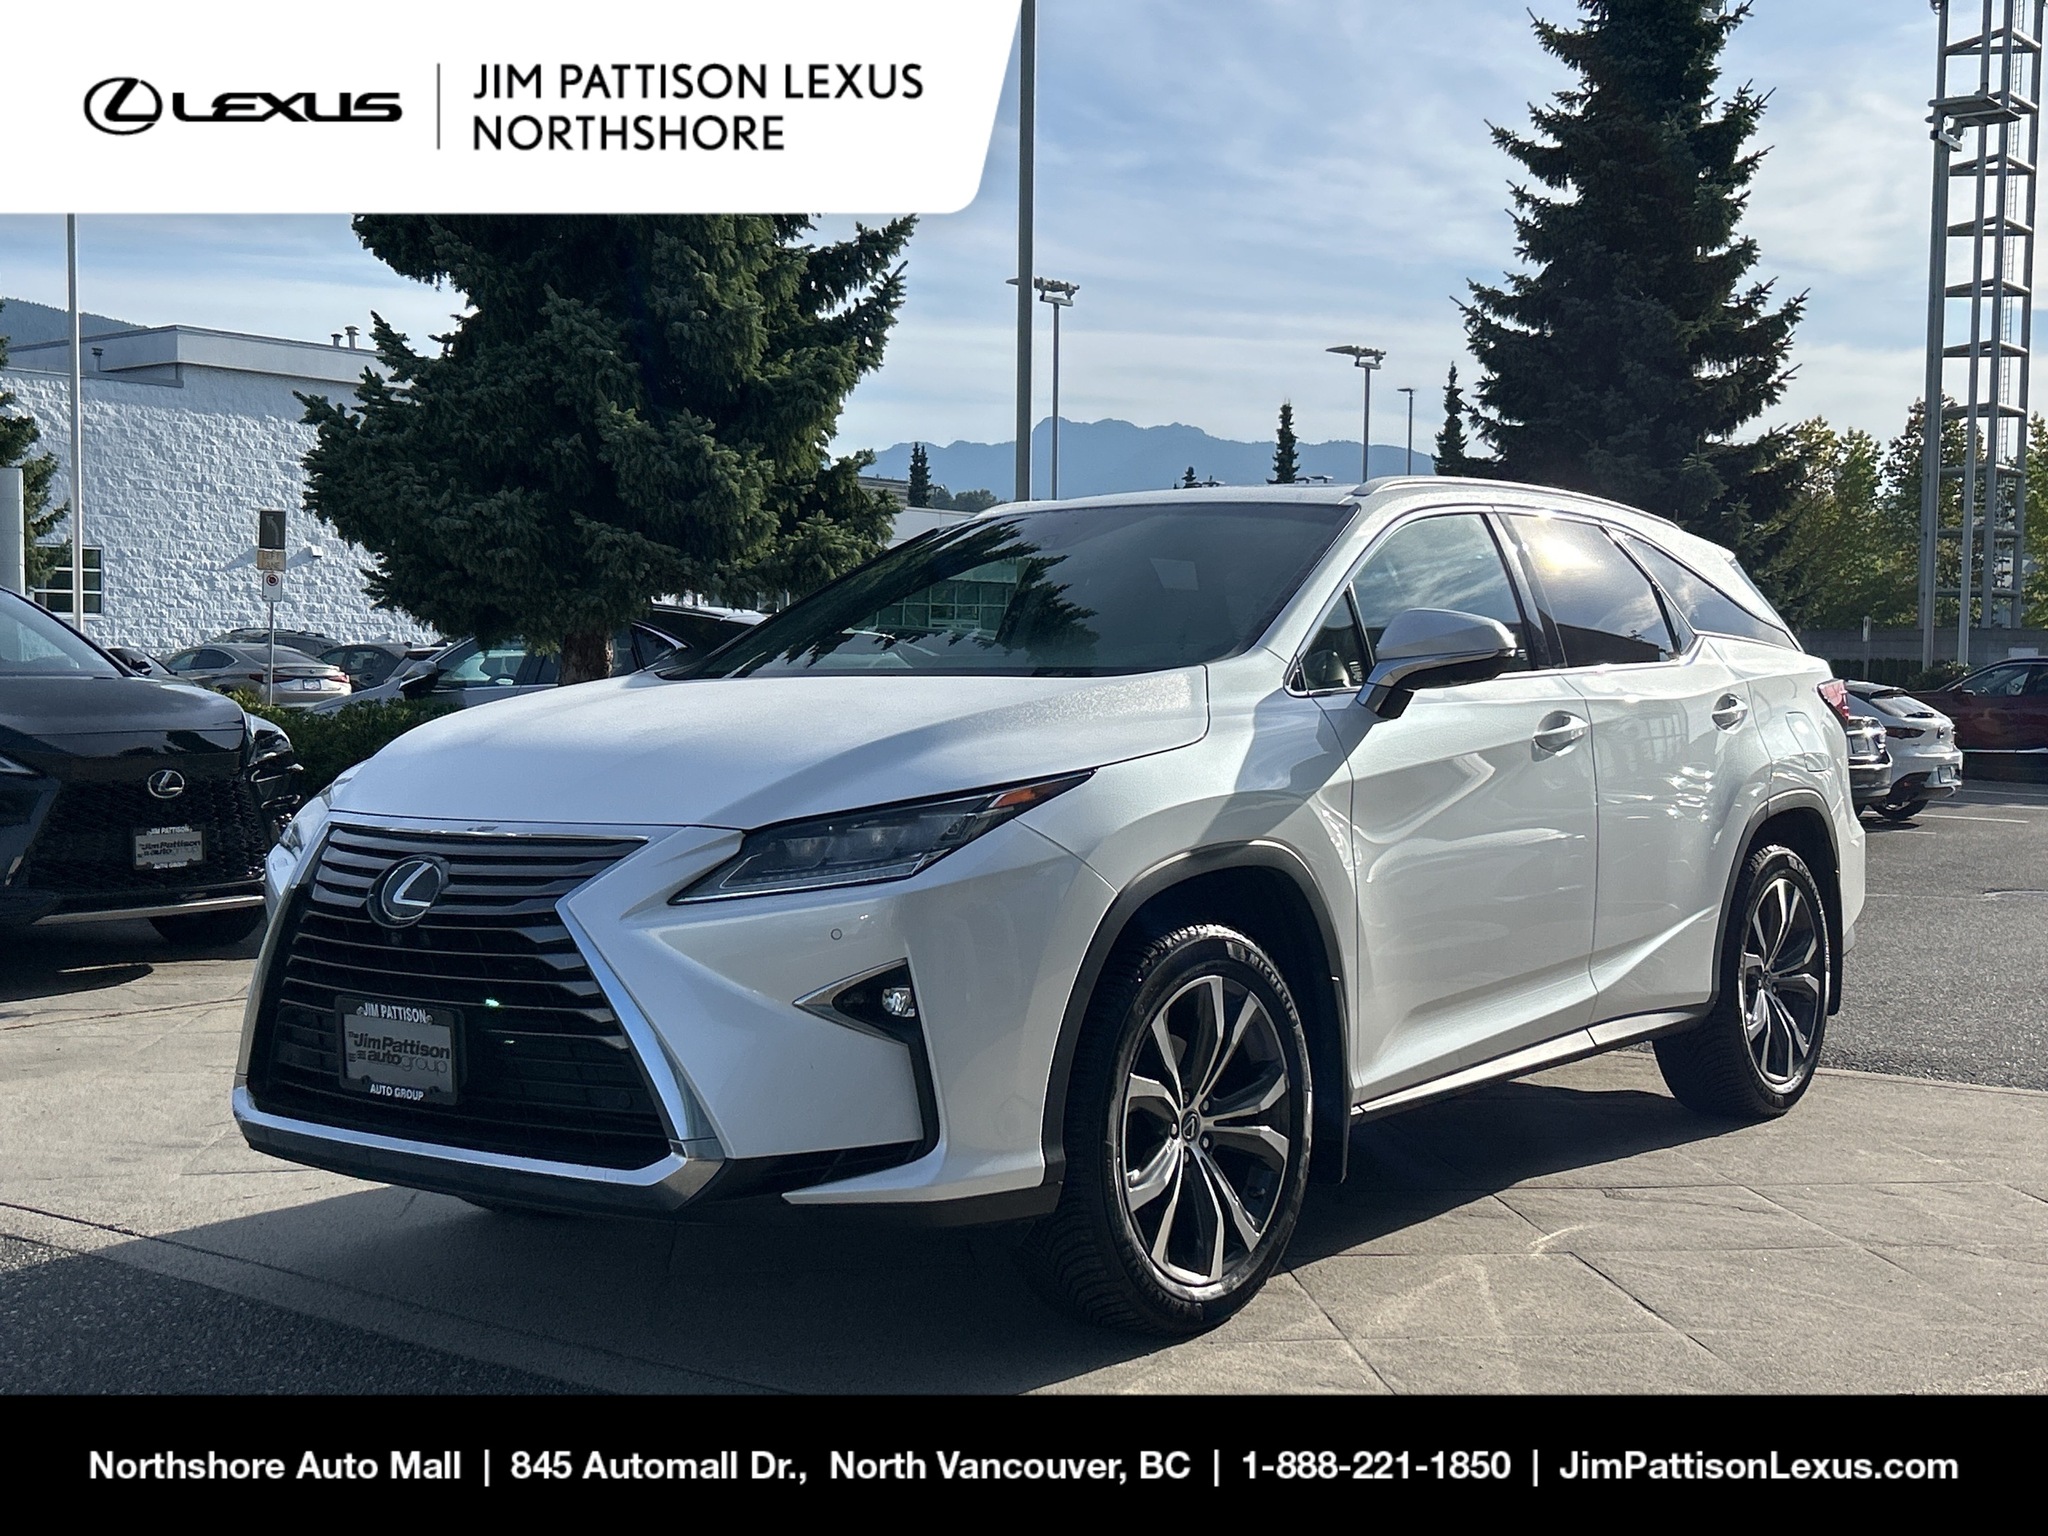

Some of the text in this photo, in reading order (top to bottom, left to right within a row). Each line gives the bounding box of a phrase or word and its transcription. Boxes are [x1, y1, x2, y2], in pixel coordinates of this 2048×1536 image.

[363, 1002, 427, 1024] JIM PATTISON
[354, 1033, 450, 1060] JimPattison
[369, 1083, 424, 1101] AUTO GROUP
